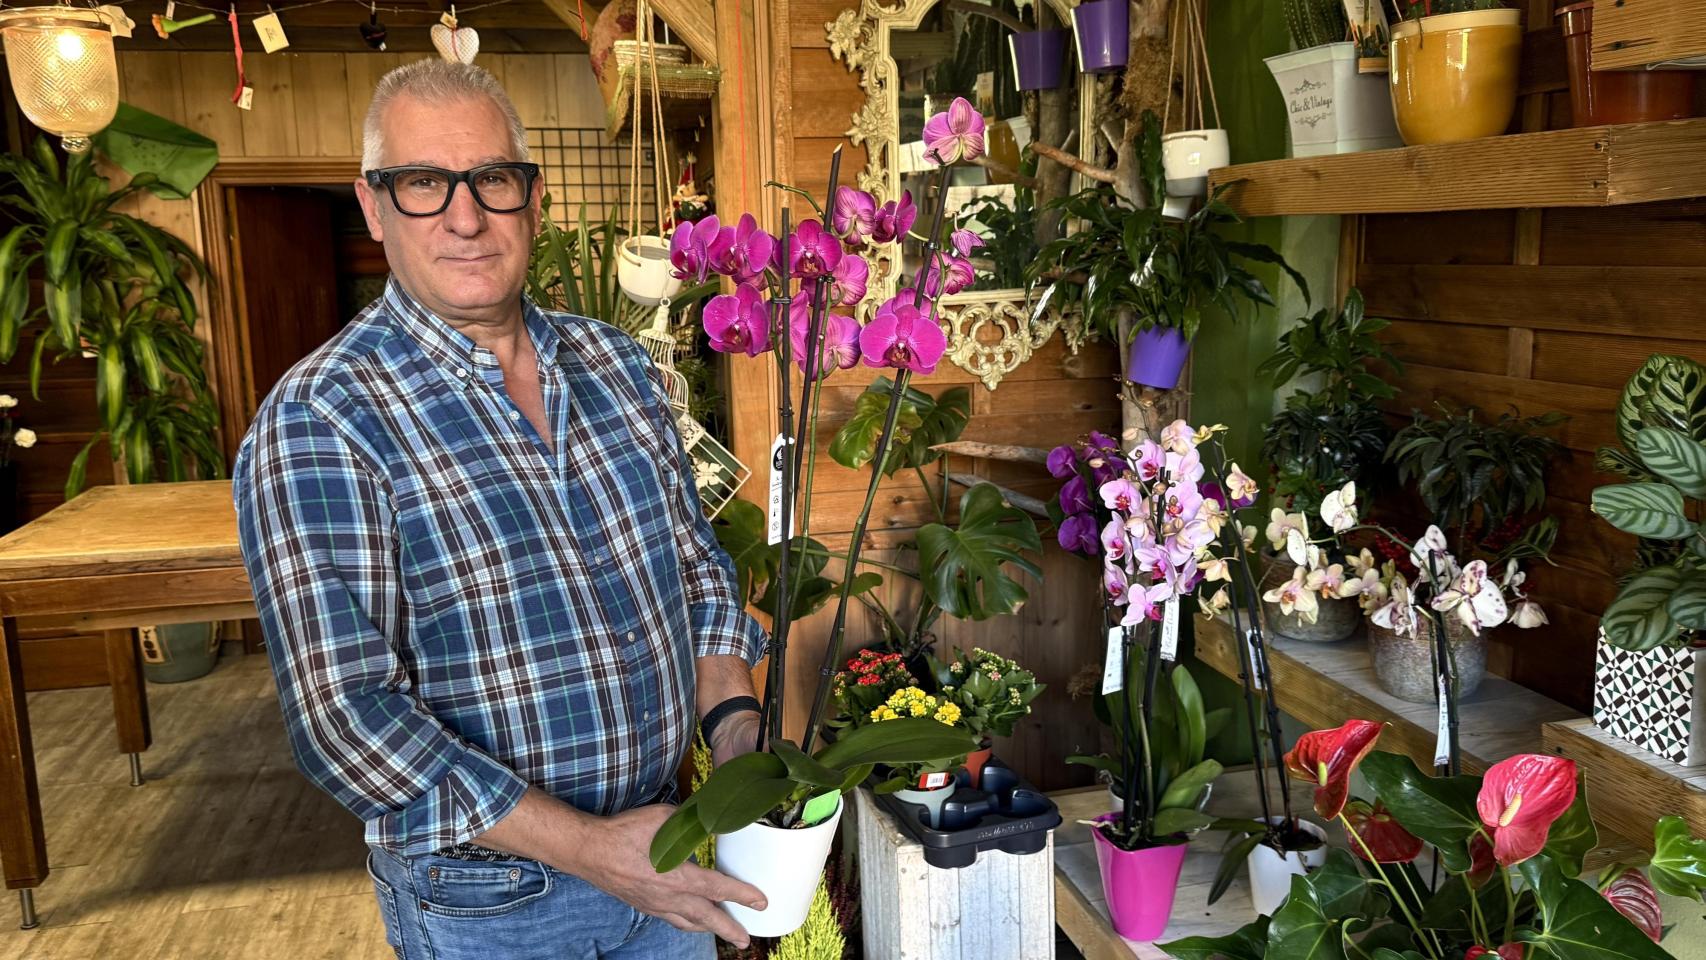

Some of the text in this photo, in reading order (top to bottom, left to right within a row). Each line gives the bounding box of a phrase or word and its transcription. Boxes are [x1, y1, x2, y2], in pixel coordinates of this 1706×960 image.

[1290, 95, 1333, 114] Chic & Vintage
